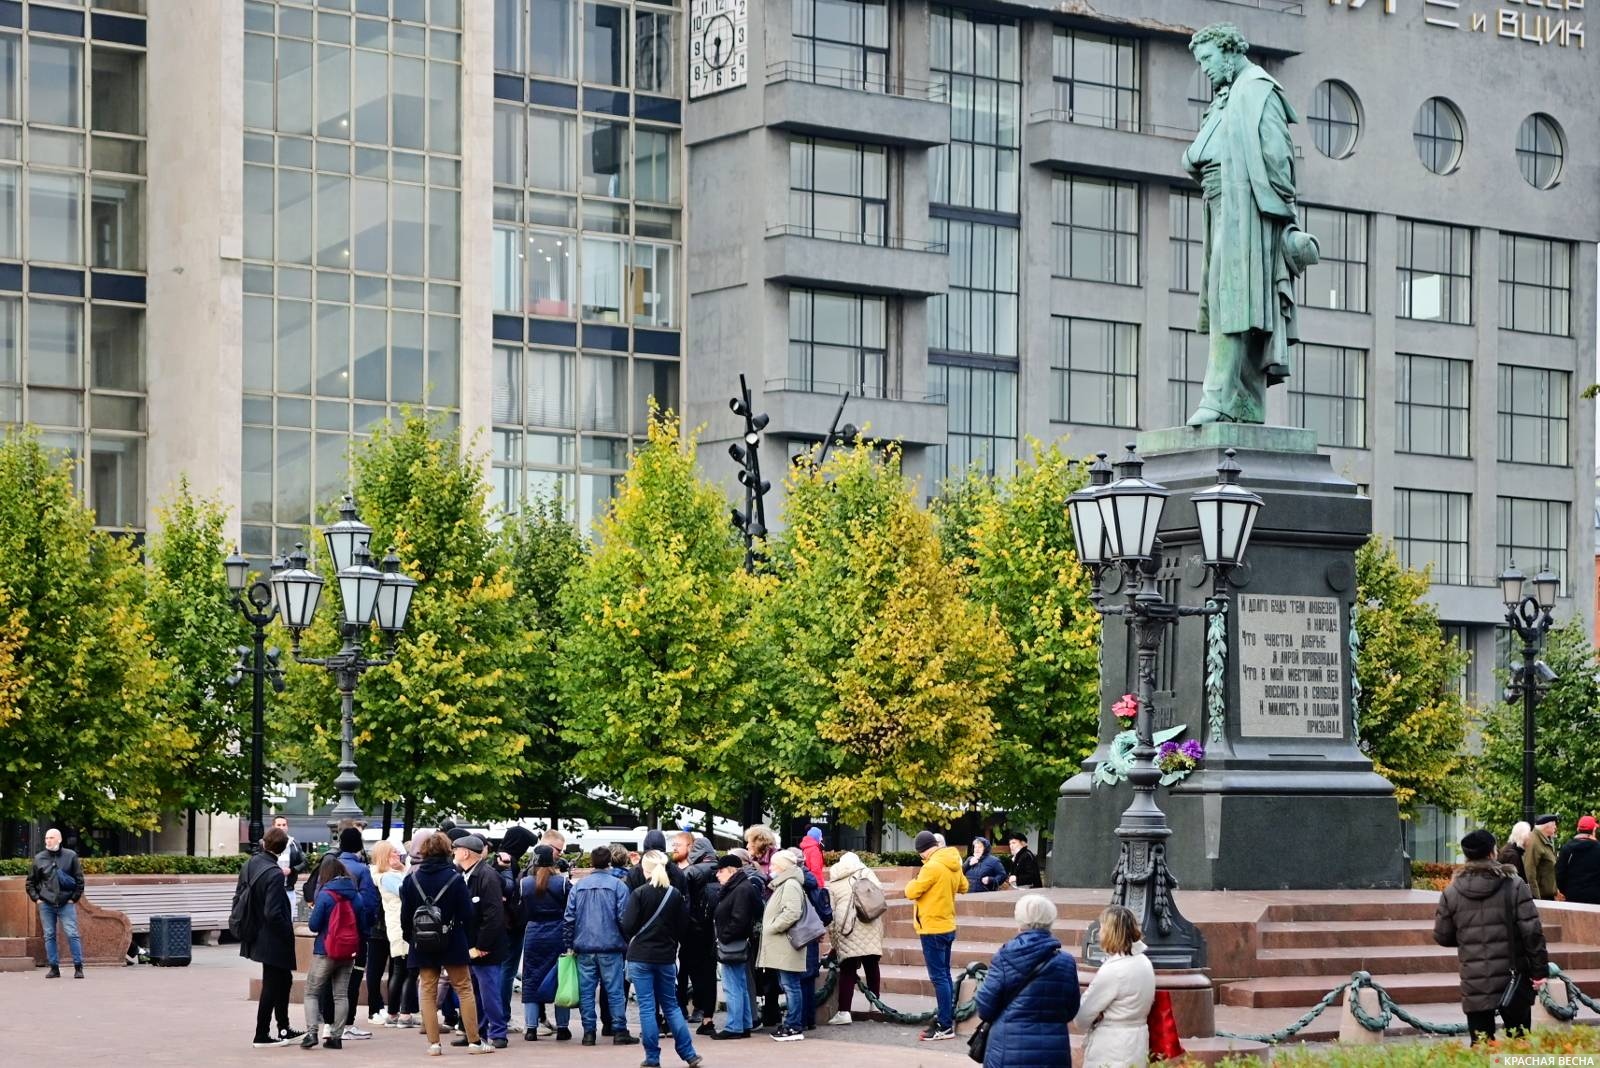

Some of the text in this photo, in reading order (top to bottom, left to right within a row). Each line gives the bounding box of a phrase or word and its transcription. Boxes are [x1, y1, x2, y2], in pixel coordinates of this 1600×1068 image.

[739, 0, 745, 15] 2
[693, 16, 701, 32] 10
[1497, 8, 1584, 48] ВЦИК
[738, 27, 744, 43] 3
[694, 42, 700, 56] 9
[739, 54, 744, 68] 4
[694, 66, 700, 80] 8
[716, 71, 722, 86] 6
[731, 67, 736, 81] 5
[703, 75, 708, 90] 7
